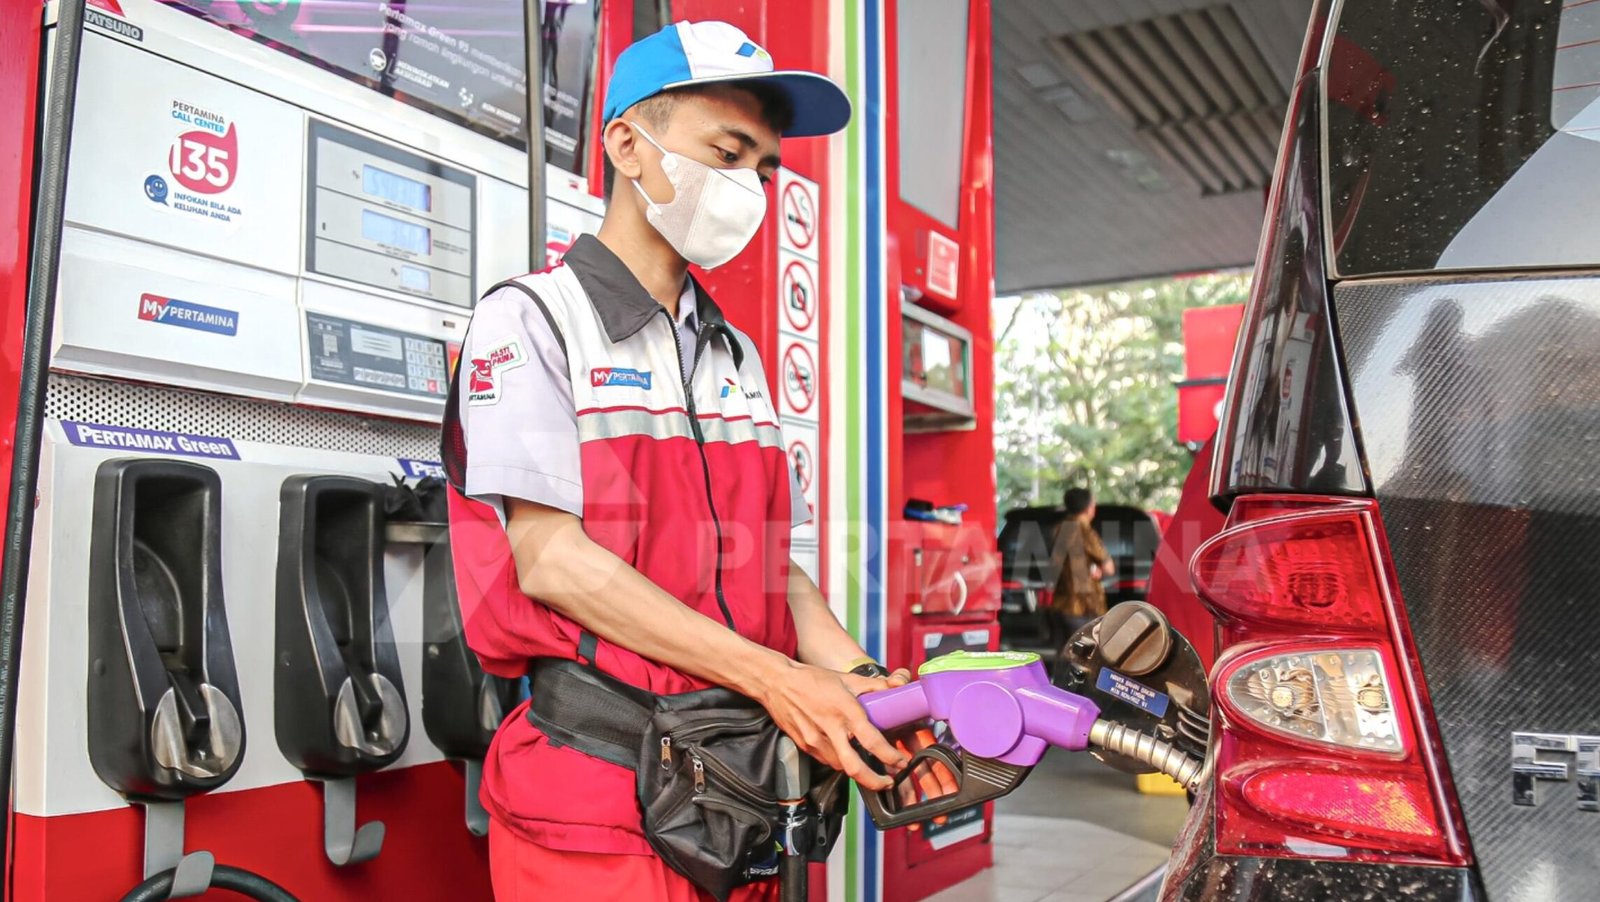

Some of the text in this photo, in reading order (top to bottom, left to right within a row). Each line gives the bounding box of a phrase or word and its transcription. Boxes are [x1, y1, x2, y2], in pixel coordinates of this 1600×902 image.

[85, 11, 141, 39] TATSUNO
[379, 3, 427, 33] Pertamax
[428, 27, 457, 47] Green
[172, 110, 225, 134] CALL CENTER
[173, 100, 225, 124] PERTAMINA
[172, 137, 230, 188] 135
[174, 192, 242, 216] INFOKAN BILA ADA
[174, 202, 231, 222] KELUHAN ANDA
[76, 425, 232, 456] PERTAMAX Green
